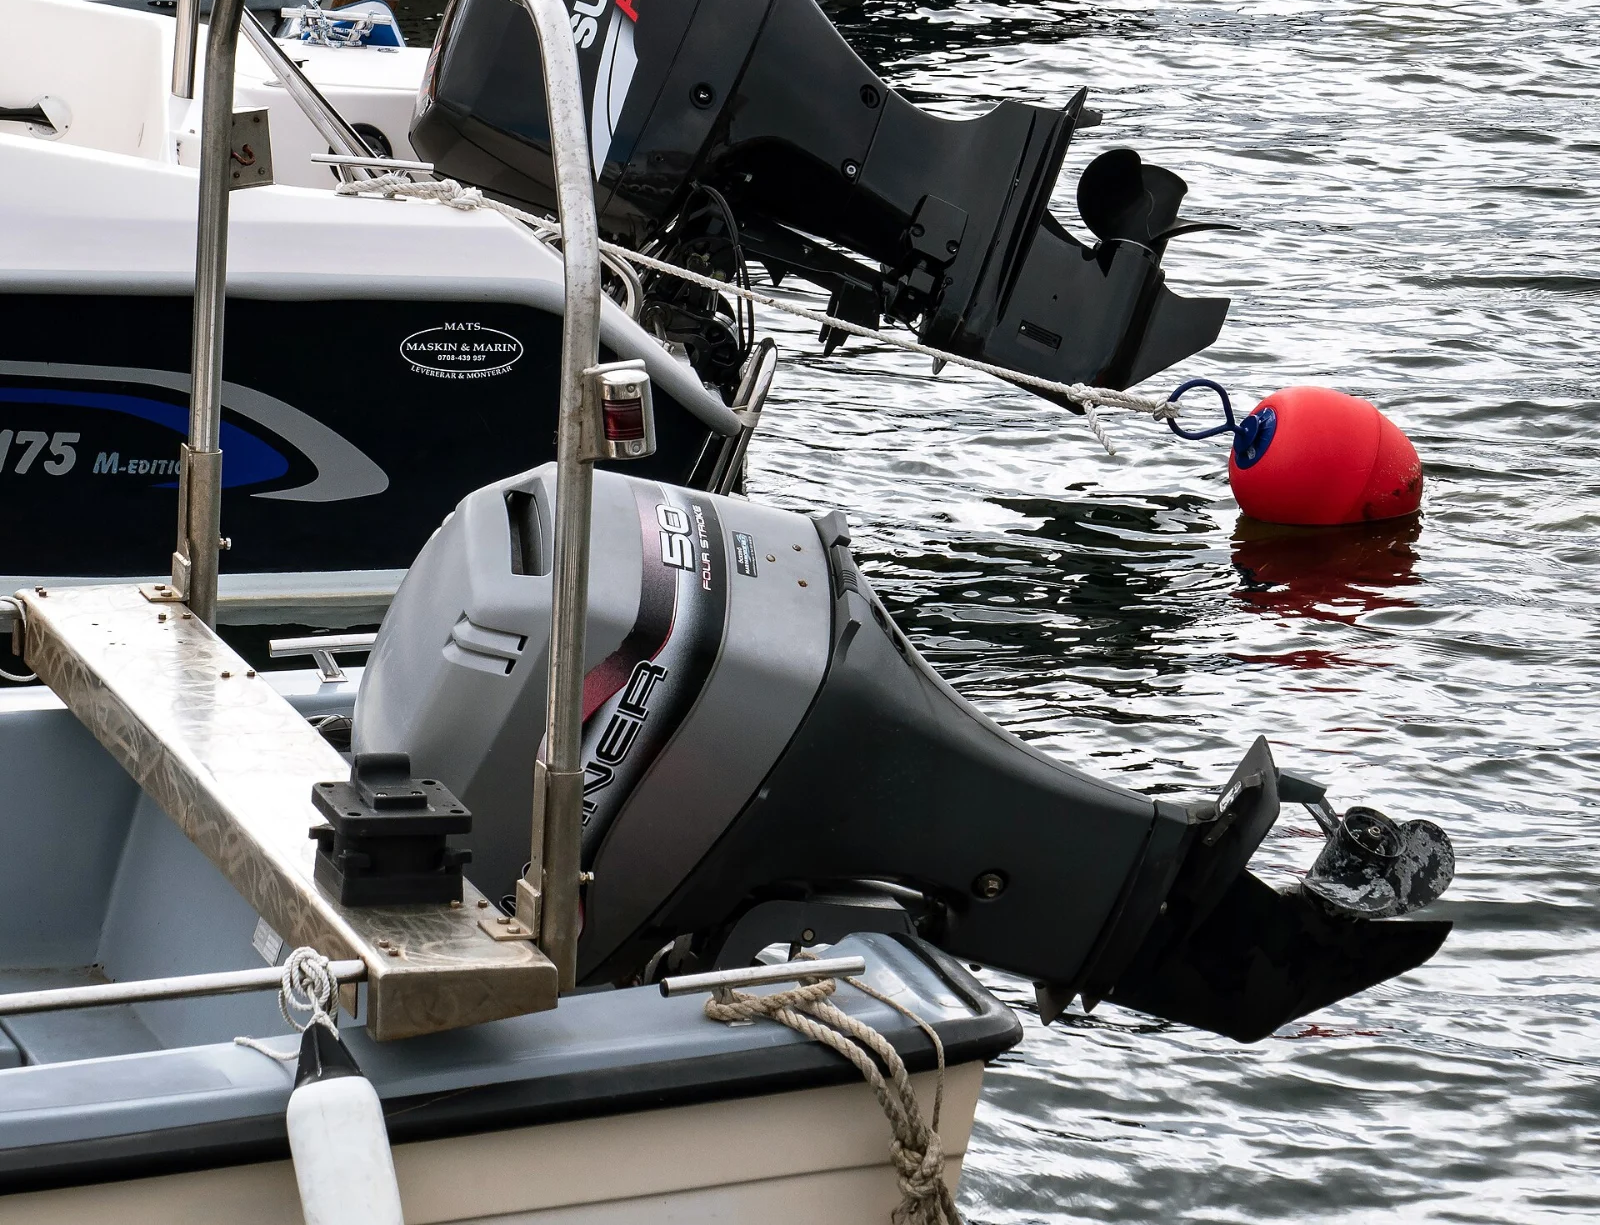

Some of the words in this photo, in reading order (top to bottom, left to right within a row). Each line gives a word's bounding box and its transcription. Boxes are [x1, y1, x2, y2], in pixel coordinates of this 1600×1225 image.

[444, 322, 481, 331] MATS
[406, 342, 458, 352] MASKIN
[460, 343, 471, 352] &
[473, 343, 517, 352] MARIN
[410, 364, 457, 379] LEVERERAR
[457, 371, 465, 380] &
[466, 365, 513, 379] MONTERAR
[655, 503, 696, 573] 50
[692, 504, 710, 549] STROKE
[701, 552, 712, 591] FOUR
